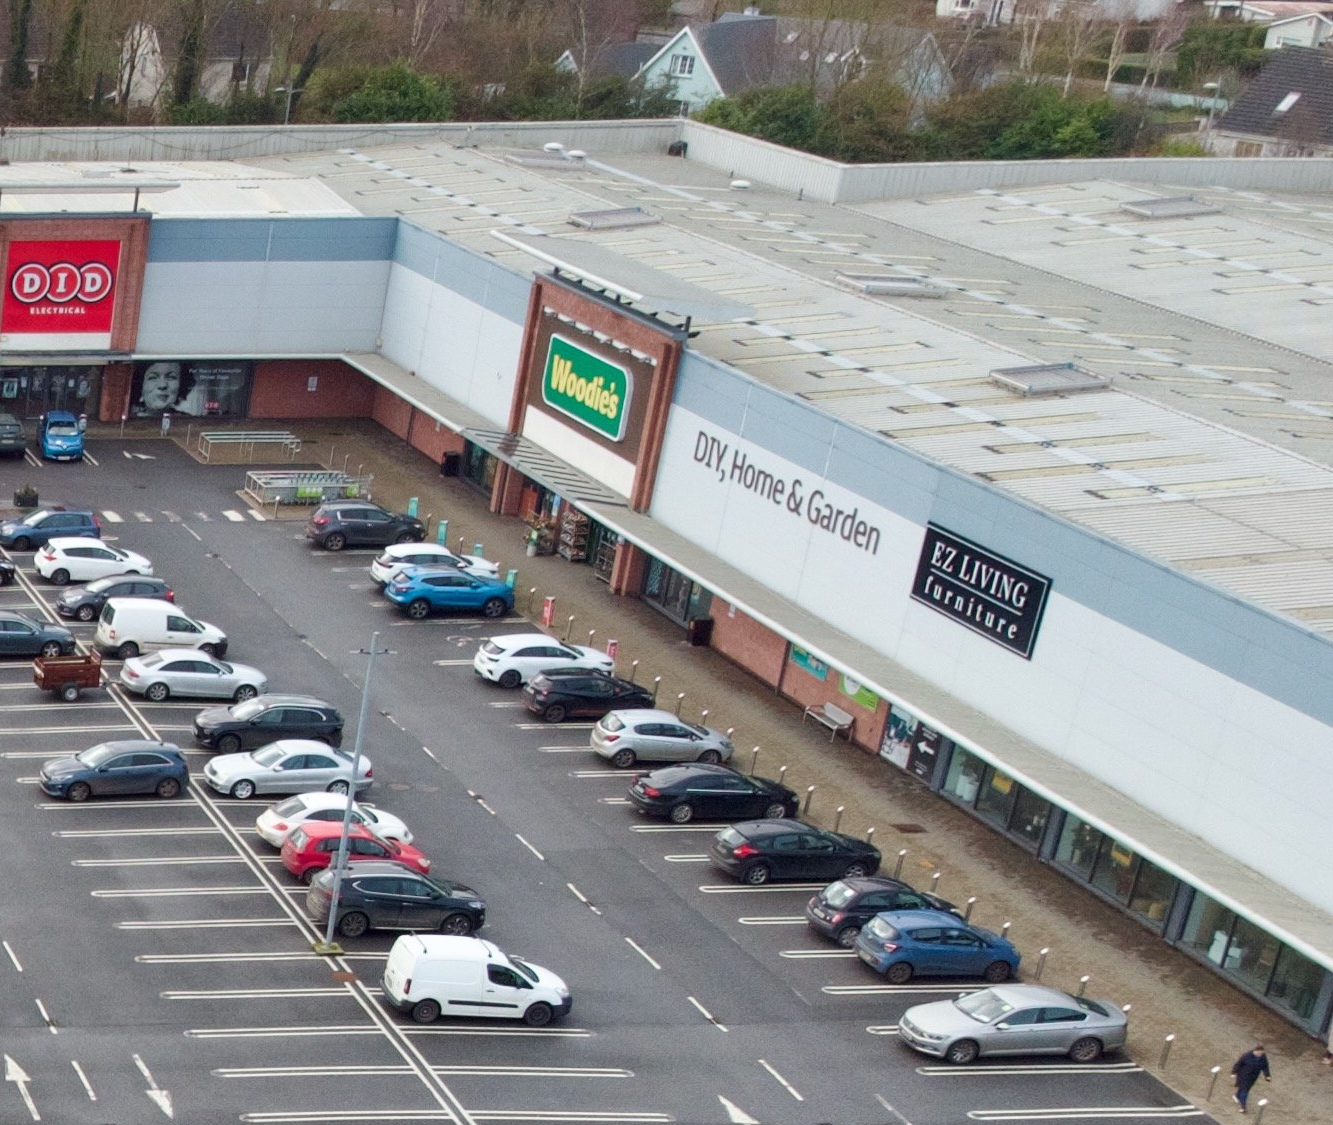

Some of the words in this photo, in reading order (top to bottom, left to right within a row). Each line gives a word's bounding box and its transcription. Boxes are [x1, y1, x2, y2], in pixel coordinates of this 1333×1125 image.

[29, 307, 86, 315] ELECTRICAL
[550, 354, 619, 419] Woodie's
[693, 430, 728, 483] DIY,
[730, 450, 786, 505] Home
[786, 479, 803, 517] &
[807, 490, 881, 555] Garden
[924, 575, 1019, 640] furniture
[931, 541, 955, 573] EZ
[958, 555, 1029, 609] LIVING
